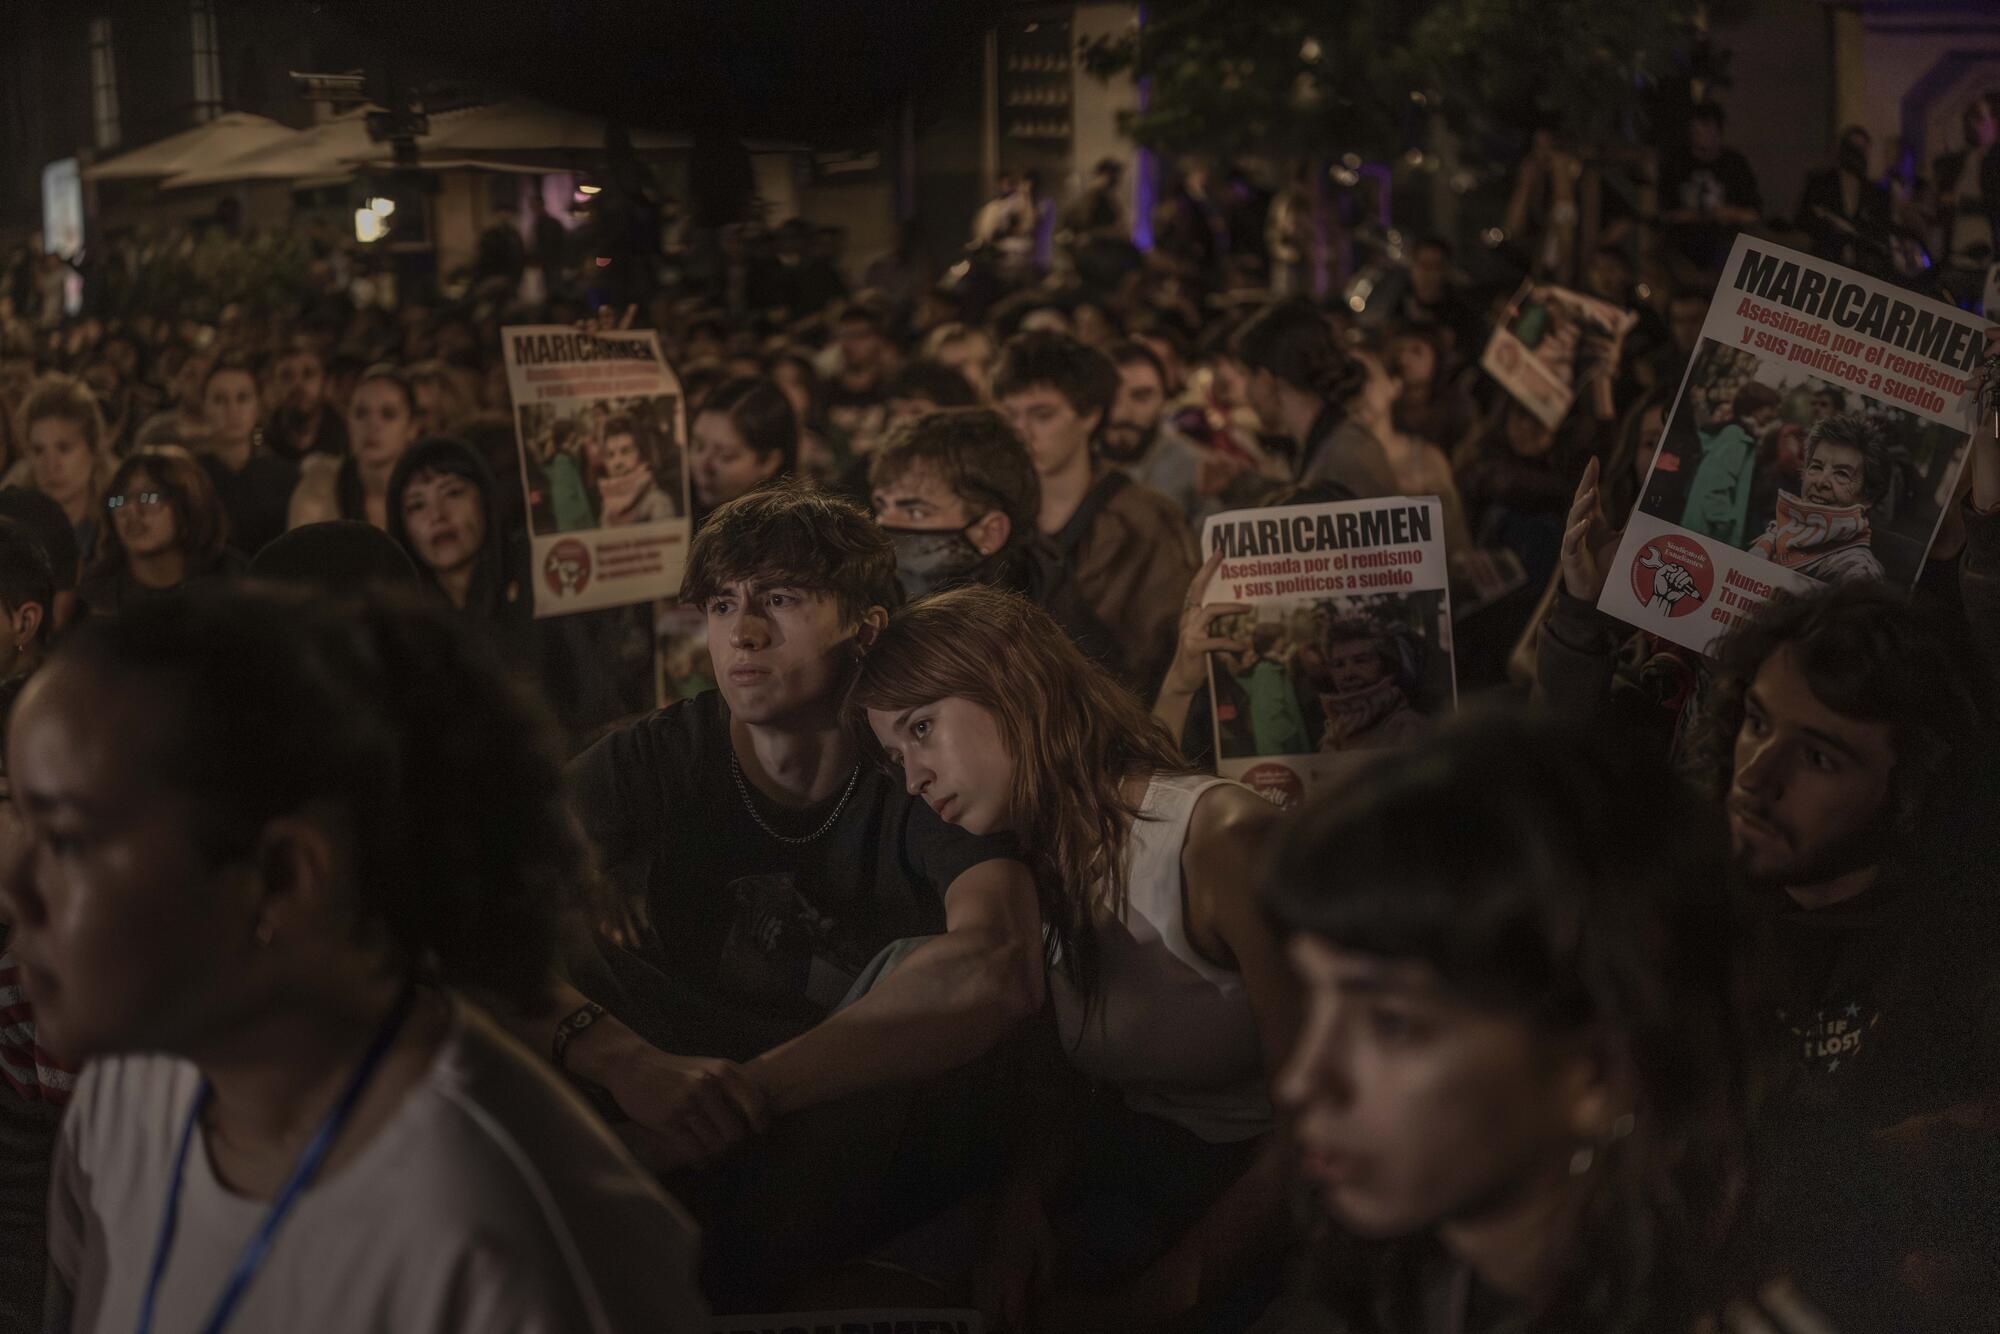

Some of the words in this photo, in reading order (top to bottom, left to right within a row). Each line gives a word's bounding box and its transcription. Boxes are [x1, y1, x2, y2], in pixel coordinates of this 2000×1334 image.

[1734, 248, 1984, 373] MARICARMEN
[1736, 297, 1829, 346] Asesinada
[1830, 328, 1866, 358] por
[1865, 344, 1885, 366] el
[1884, 348, 1965, 396] rentismo
[1740, 325, 1754, 344] y
[1755, 330, 1789, 356] sus
[1787, 342, 1869, 385] políticos
[1868, 373, 1883, 391] a
[1882, 377, 1946, 414] sueldo
[1211, 505, 1432, 559] MARICARMEN
[1221, 557, 1301, 580] Asesinada
[1305, 559, 1330, 575] por
[1334, 553, 1349, 571] el
[1351, 549, 1423, 569] rentismo
[1233, 584, 1243, 599] y
[1245, 581, 1273, 597] sus
[1276, 574, 1344, 596] políticos
[1347, 575, 1357, 589] a
[1359, 569, 1413, 588] sueldo
[1719, 586, 1738, 606] Tu
[1724, 567, 1772, 598] Nunca
[1710, 607, 1731, 625] en
[1817, 1029, 1862, 1057] LOST
